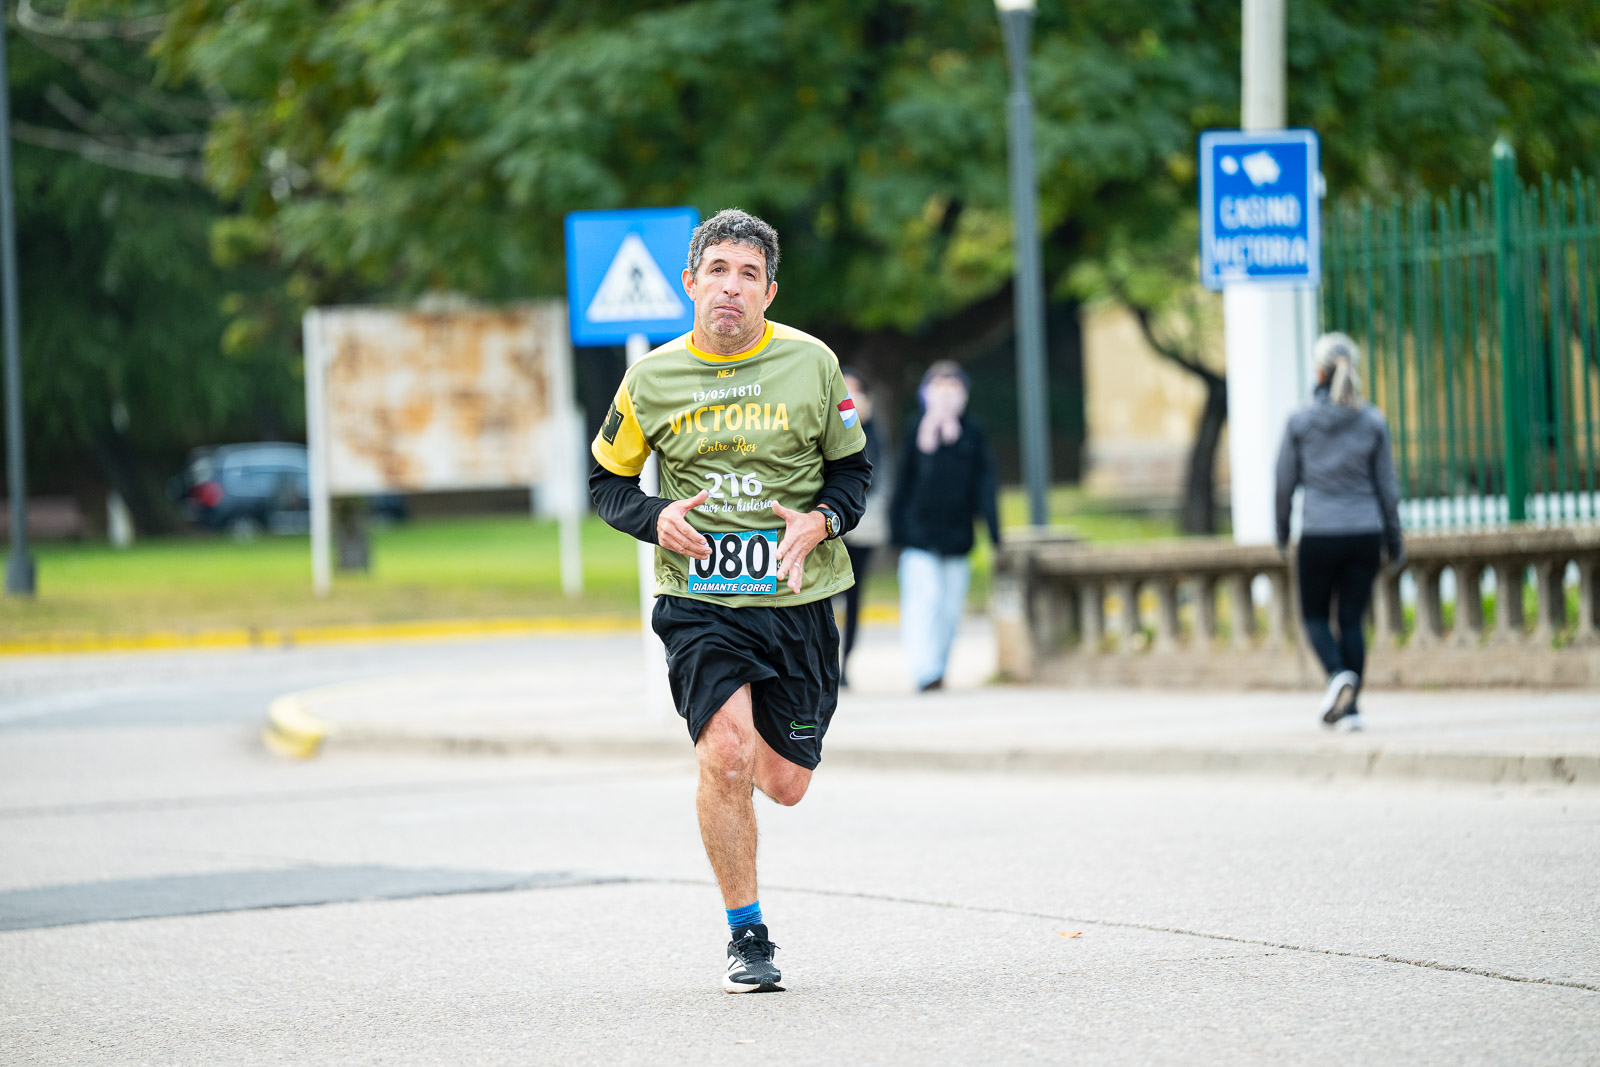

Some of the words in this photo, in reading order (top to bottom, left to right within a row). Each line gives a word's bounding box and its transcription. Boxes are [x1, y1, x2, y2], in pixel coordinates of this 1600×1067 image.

[1220, 195, 1301, 229] CASINO
[717, 369, 736, 378] NEJ
[692, 384, 761, 402] 13/05/1810
[668, 403, 789, 434] VICTORIA
[697, 437, 729, 454] Entre
[705, 472, 762, 498] 216
[722, 500, 734, 512] de
[737, 498, 773, 512] historia
[695, 534, 769, 580] 080
[692, 583, 739, 591] DIAMANTE
[740, 584, 772, 592] CORRE
